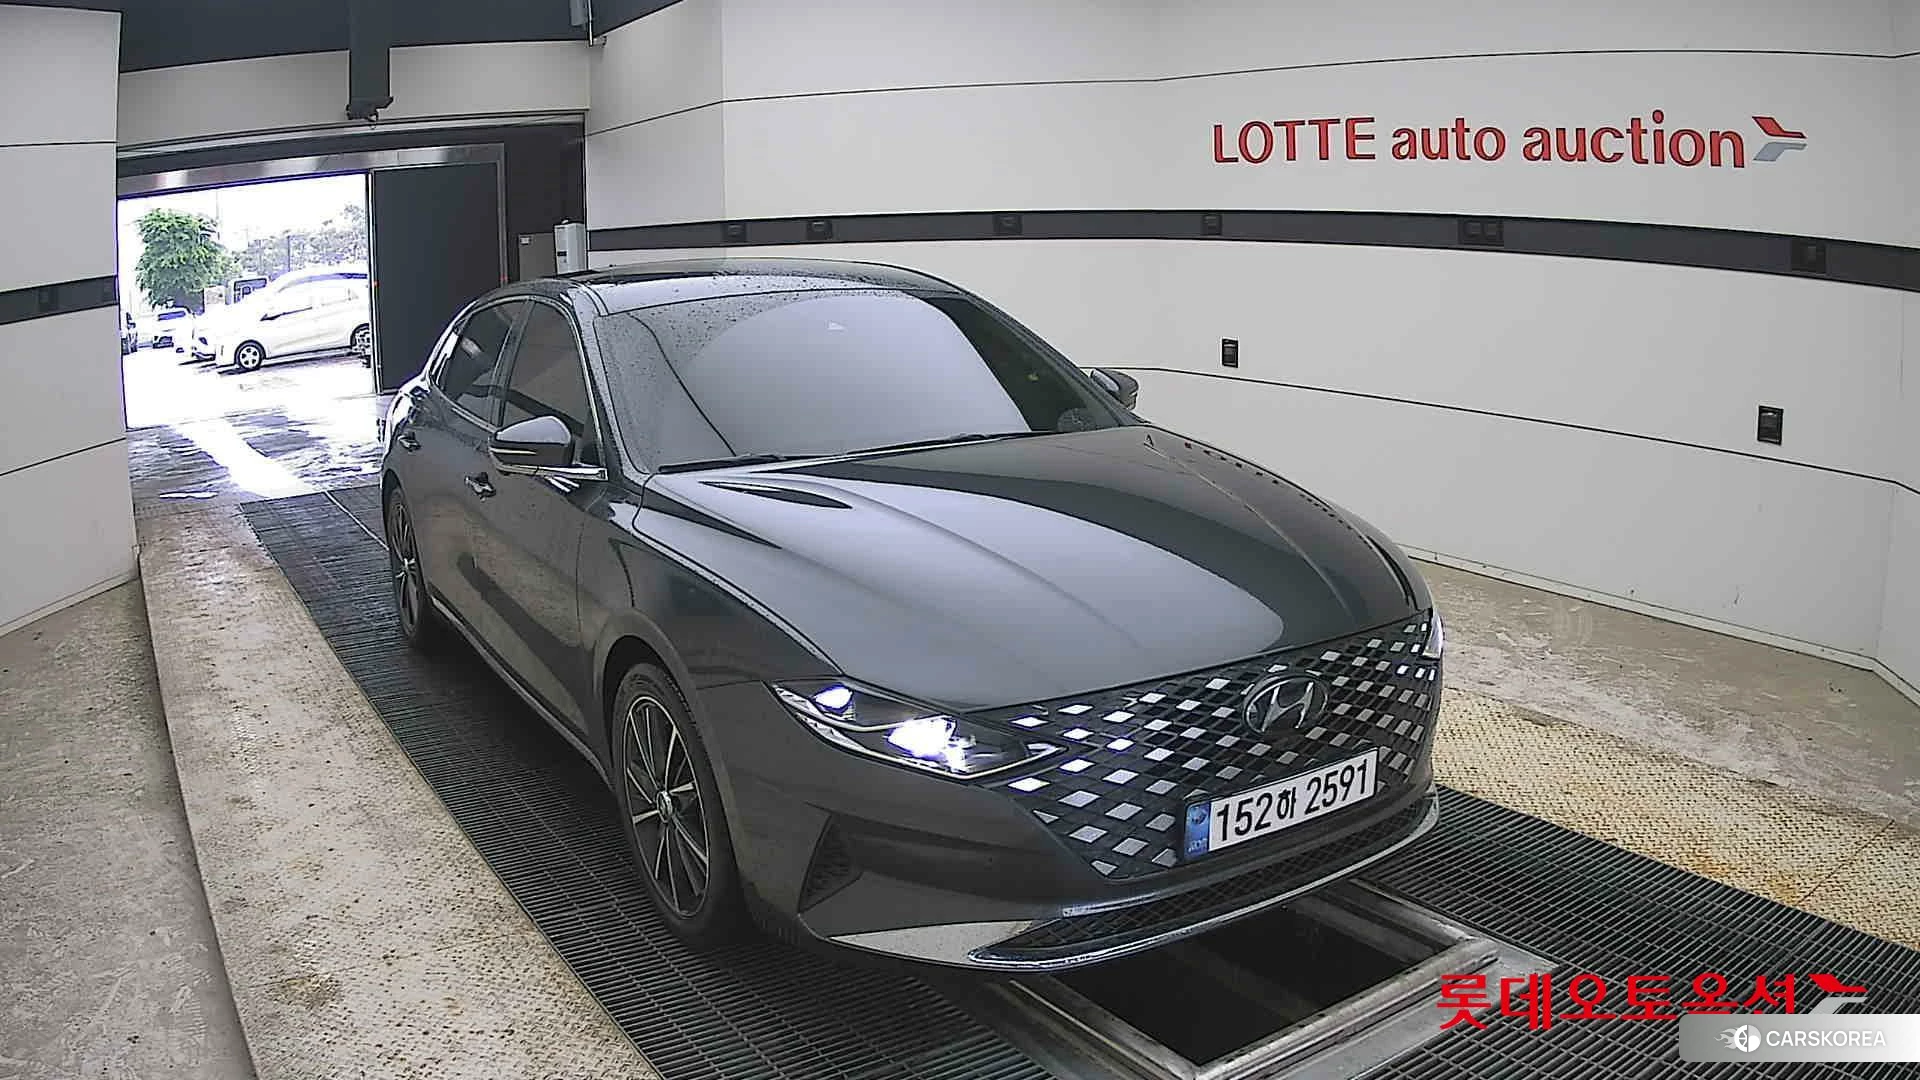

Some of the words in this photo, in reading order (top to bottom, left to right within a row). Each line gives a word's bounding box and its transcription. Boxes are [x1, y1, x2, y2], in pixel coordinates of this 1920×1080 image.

[1212, 116, 1377, 164] LOTTE
[1391, 117, 1507, 161] auto
[1522, 109, 1746, 169] auction
[1216, 786, 1297, 842] 152하
[1304, 758, 1369, 816] 2591
